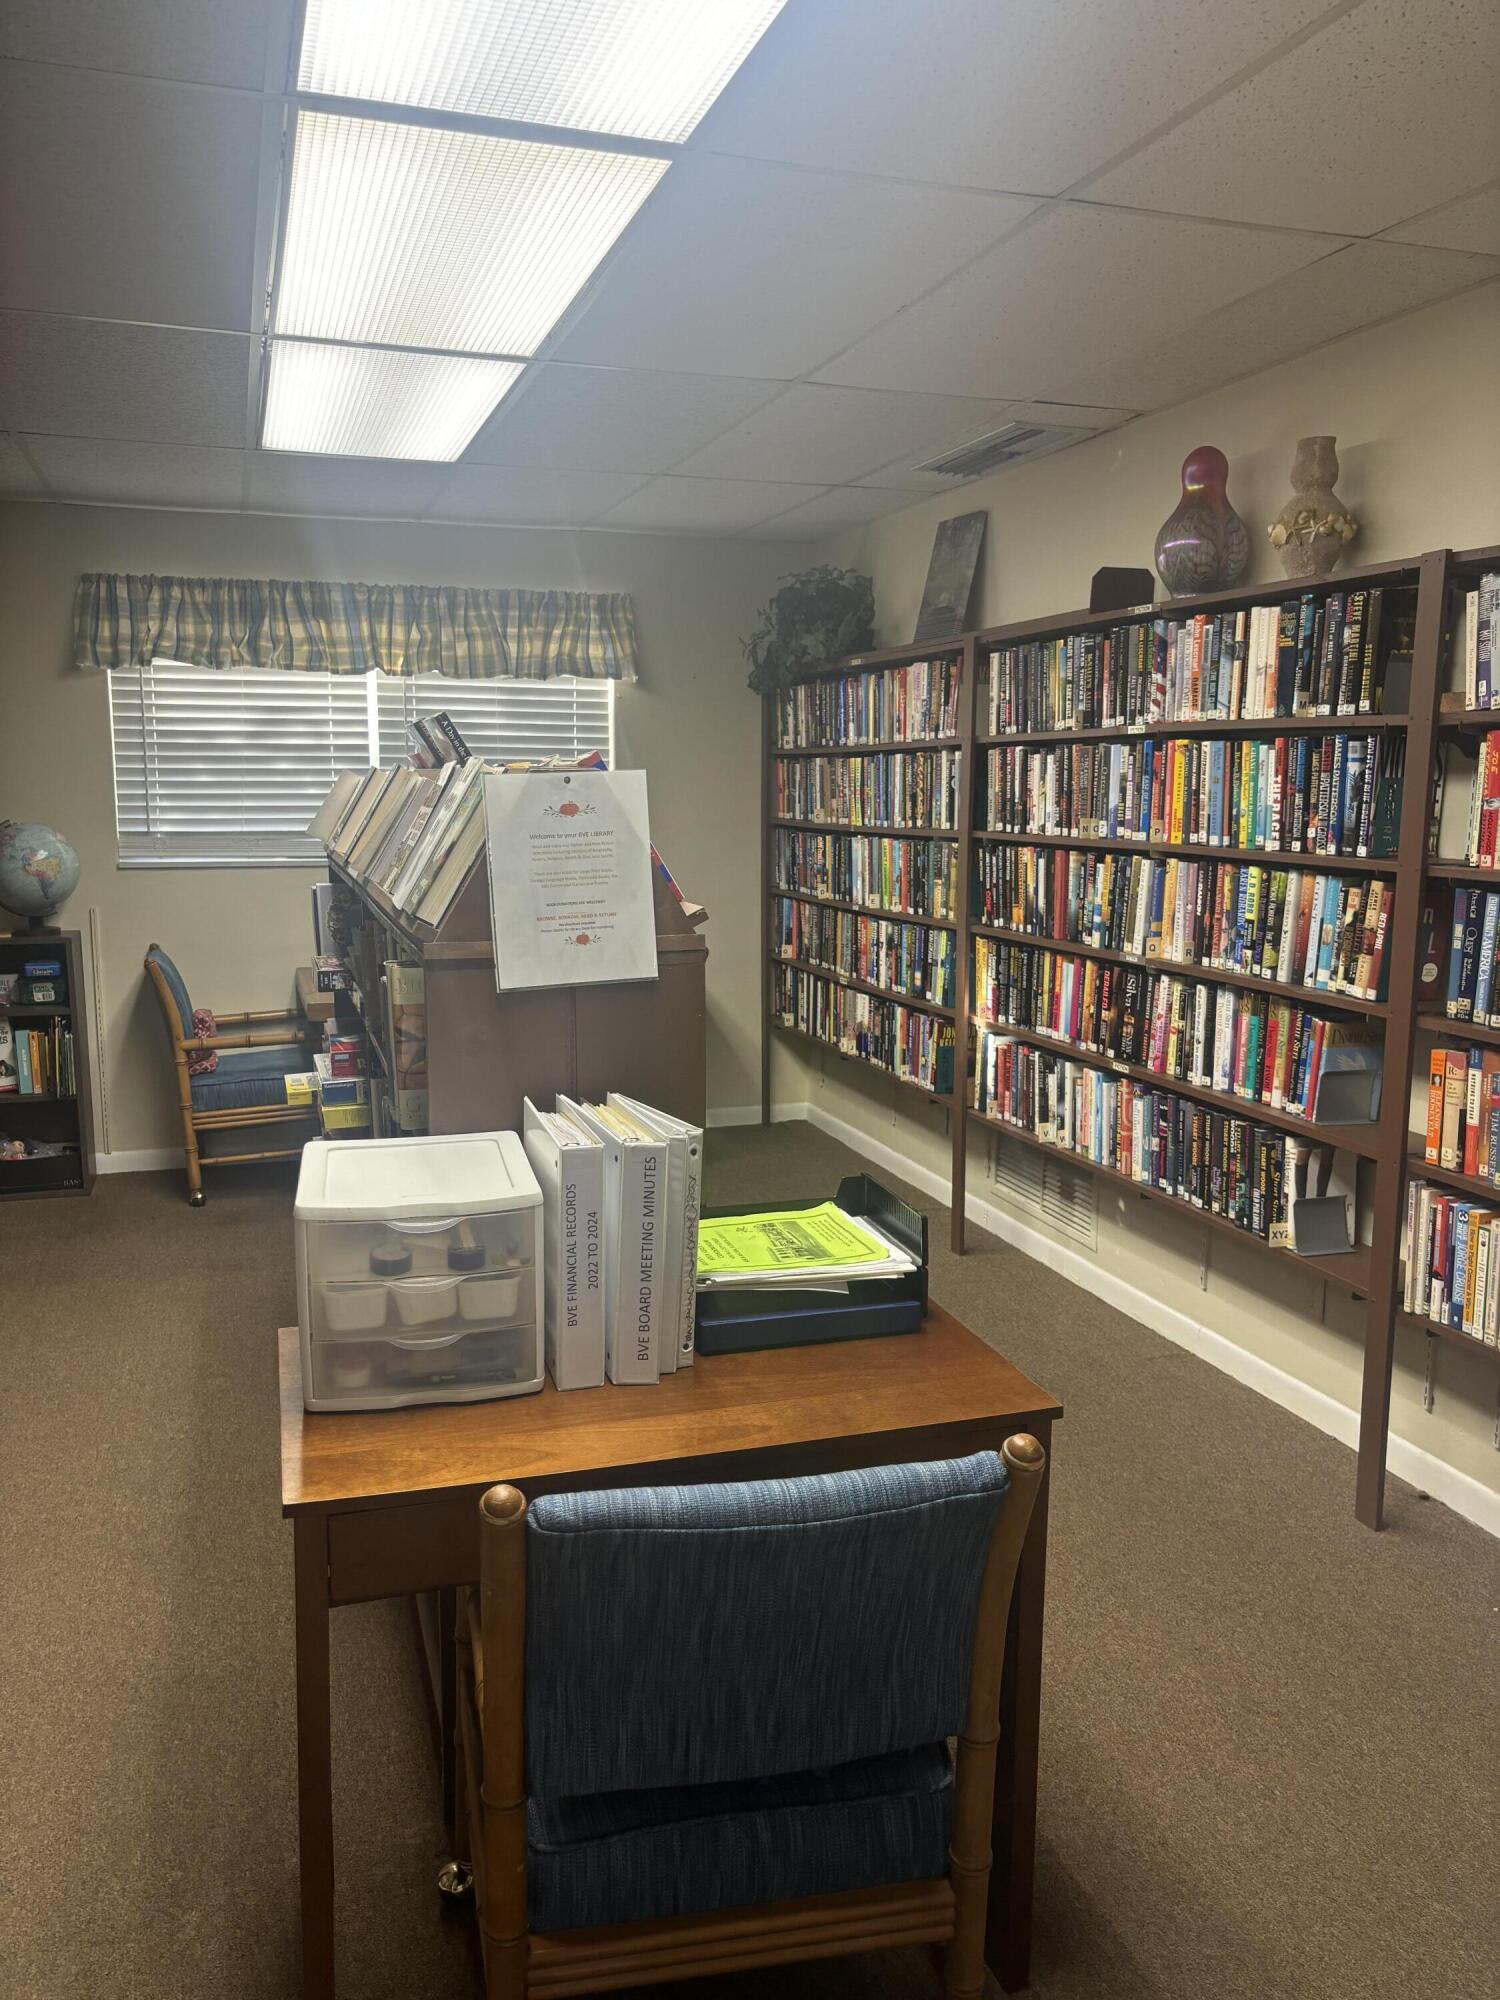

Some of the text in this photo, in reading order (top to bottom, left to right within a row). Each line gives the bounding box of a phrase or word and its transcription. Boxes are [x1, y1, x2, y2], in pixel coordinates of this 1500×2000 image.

[1348, 596, 1364, 662] STEVE MARTINI
[1361, 644, 1373, 700] STEVE MARTINI
[1299, 700, 1307, 710] M
[1329, 739, 1343, 825] JAMES PATTERSON
[1491, 750, 1499, 775] JOE
[1271, 803, 1280, 840] RACE
[1316, 778, 1331, 850] PATTERSON GROSS
[1484, 811, 1495, 857] HOLLYWOOD
[1247, 892, 1255, 914] ROBB
[1336, 892, 1344, 918] SUSPECT
[1374, 912, 1387, 951] RED APRIL
[1463, 927, 1478, 953] QUEST
[1185, 949, 1193, 957] R
[1478, 937, 1492, 980] AMERICA
[1102, 969, 1111, 1010] DERAILED
[1124, 977, 1137, 1008] Silva
[1292, 1039, 1302, 1060] STEEL
[1428, 1089, 1438, 1137] ROOSEVELT
[1433, 1090, 1442, 1130] ELEANOR
[1488, 1111, 1499, 1180] TIM RUSSERT
[1273, 1171, 1281, 1197] Short
[565, 1183, 579, 1327] BVE FINANCIAL RECORDS
[587, 1211, 599, 1290] 2022 TO 2024
[637, 1156, 657, 1361] BVE BOARD MEETING MINUTES
[1456, 1242, 1468, 1269] JORGE
[1454, 1271, 1468, 1304] CRUISE
[1476, 1262, 1487, 1298] HEALTH
